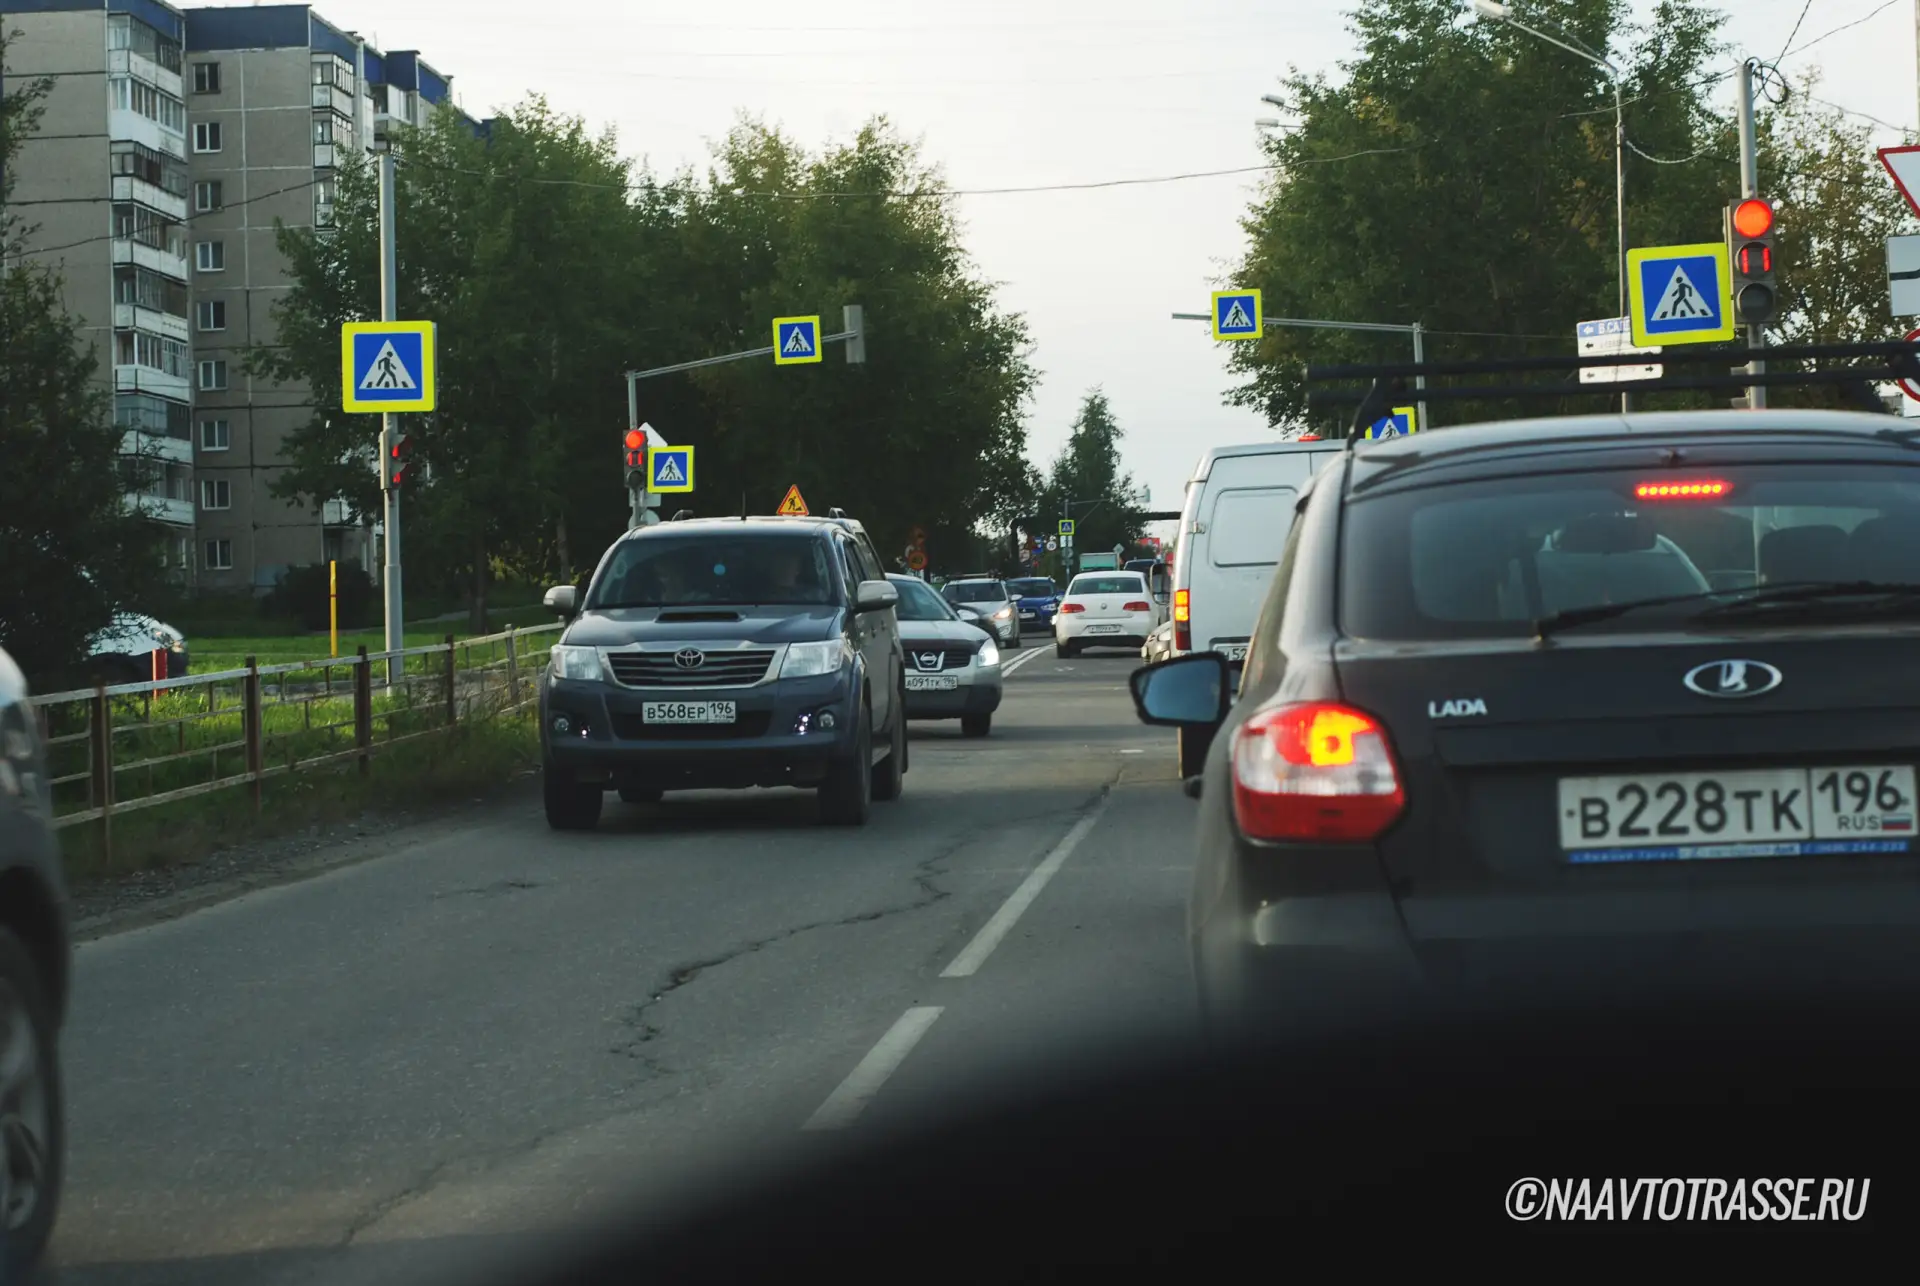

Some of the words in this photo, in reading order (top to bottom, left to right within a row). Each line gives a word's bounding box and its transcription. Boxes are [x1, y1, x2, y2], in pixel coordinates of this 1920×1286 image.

[709, 702, 732, 714] 196
[1428, 699, 1488, 718] LADA
[1580, 780, 1803, 839] В228ТК
[1816, 770, 1902, 814] 196
[1837, 814, 1881, 831] RUS
